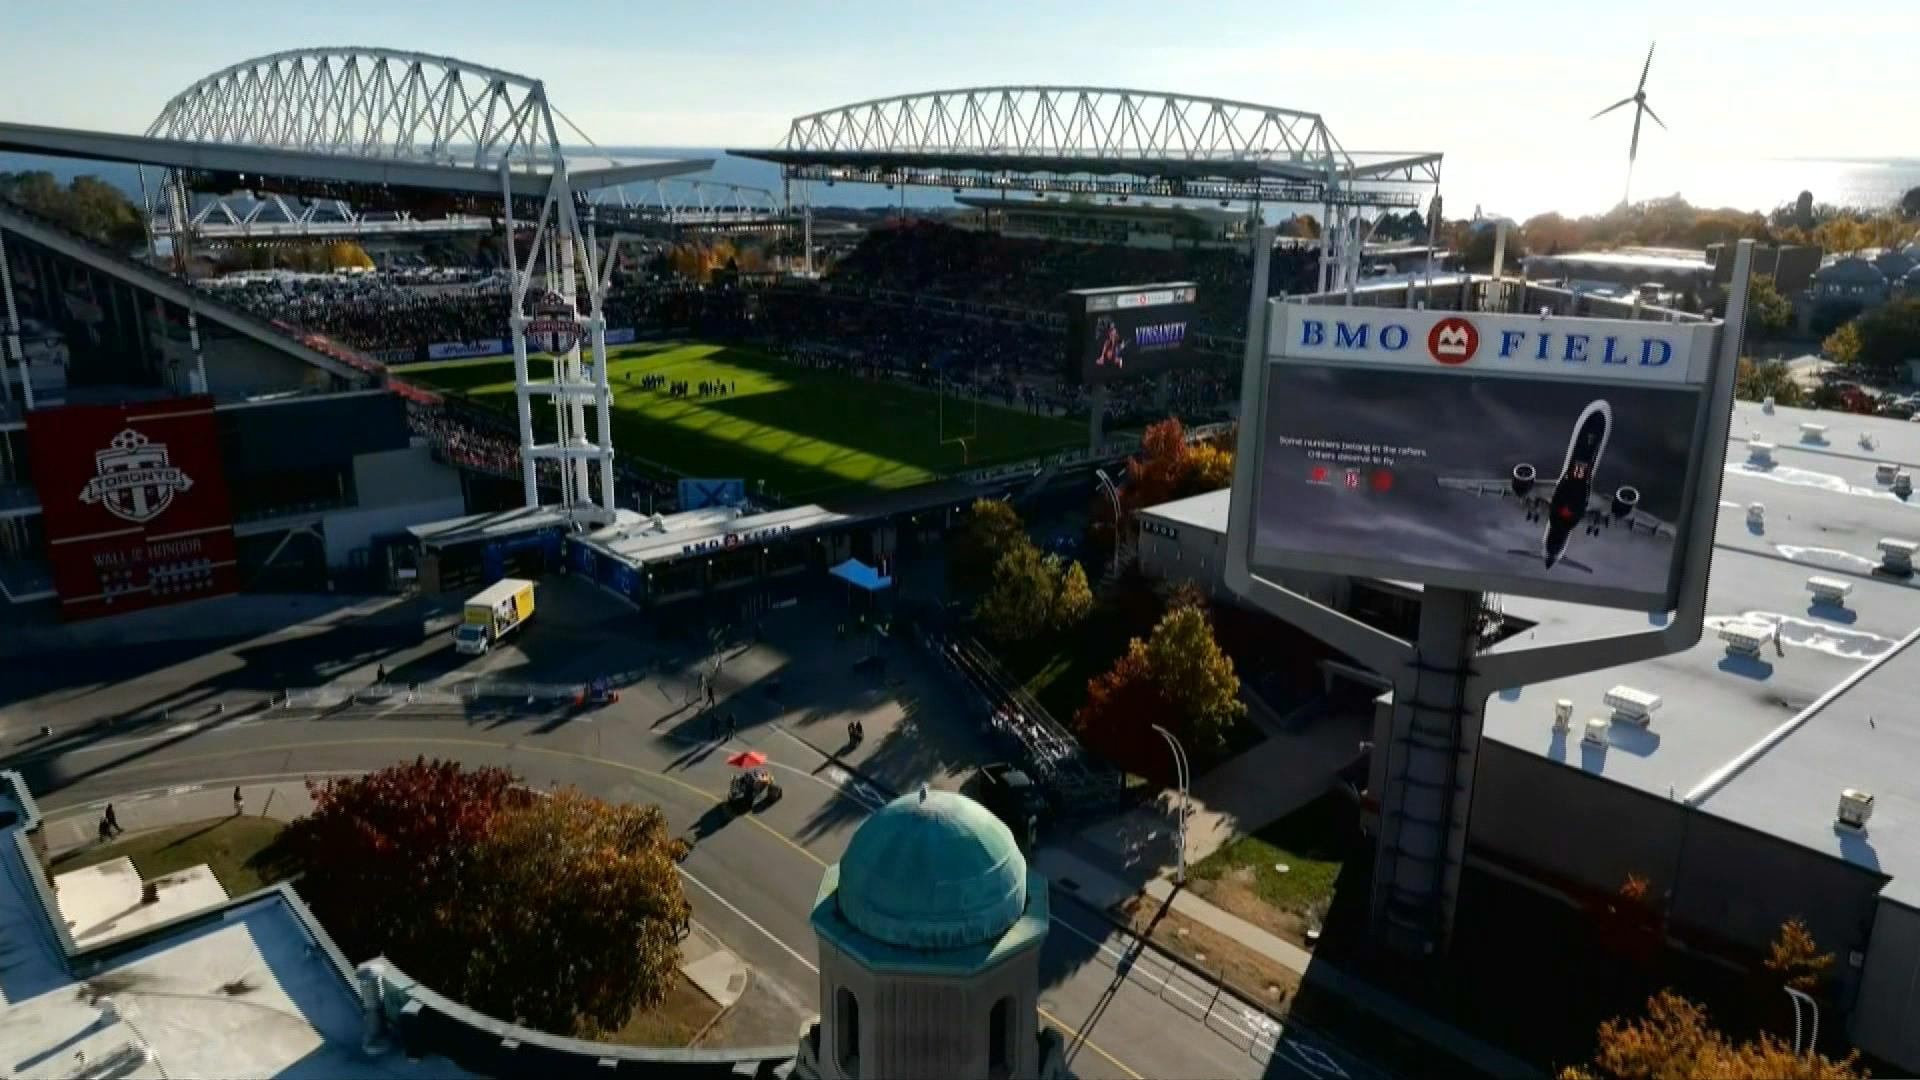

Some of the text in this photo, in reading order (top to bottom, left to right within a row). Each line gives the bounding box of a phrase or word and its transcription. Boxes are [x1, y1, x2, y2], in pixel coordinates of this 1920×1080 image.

[1136, 322, 1187, 345] VINSANITY
[1300, 319, 1673, 367] BMO FIELD
[1304, 438, 1341, 449] numbers
[1342, 442, 1371, 454] belong
[1307, 449, 1336, 460] Others
[1336, 452, 1370, 463] deserve
[97, 468, 178, 491] TORONTO
